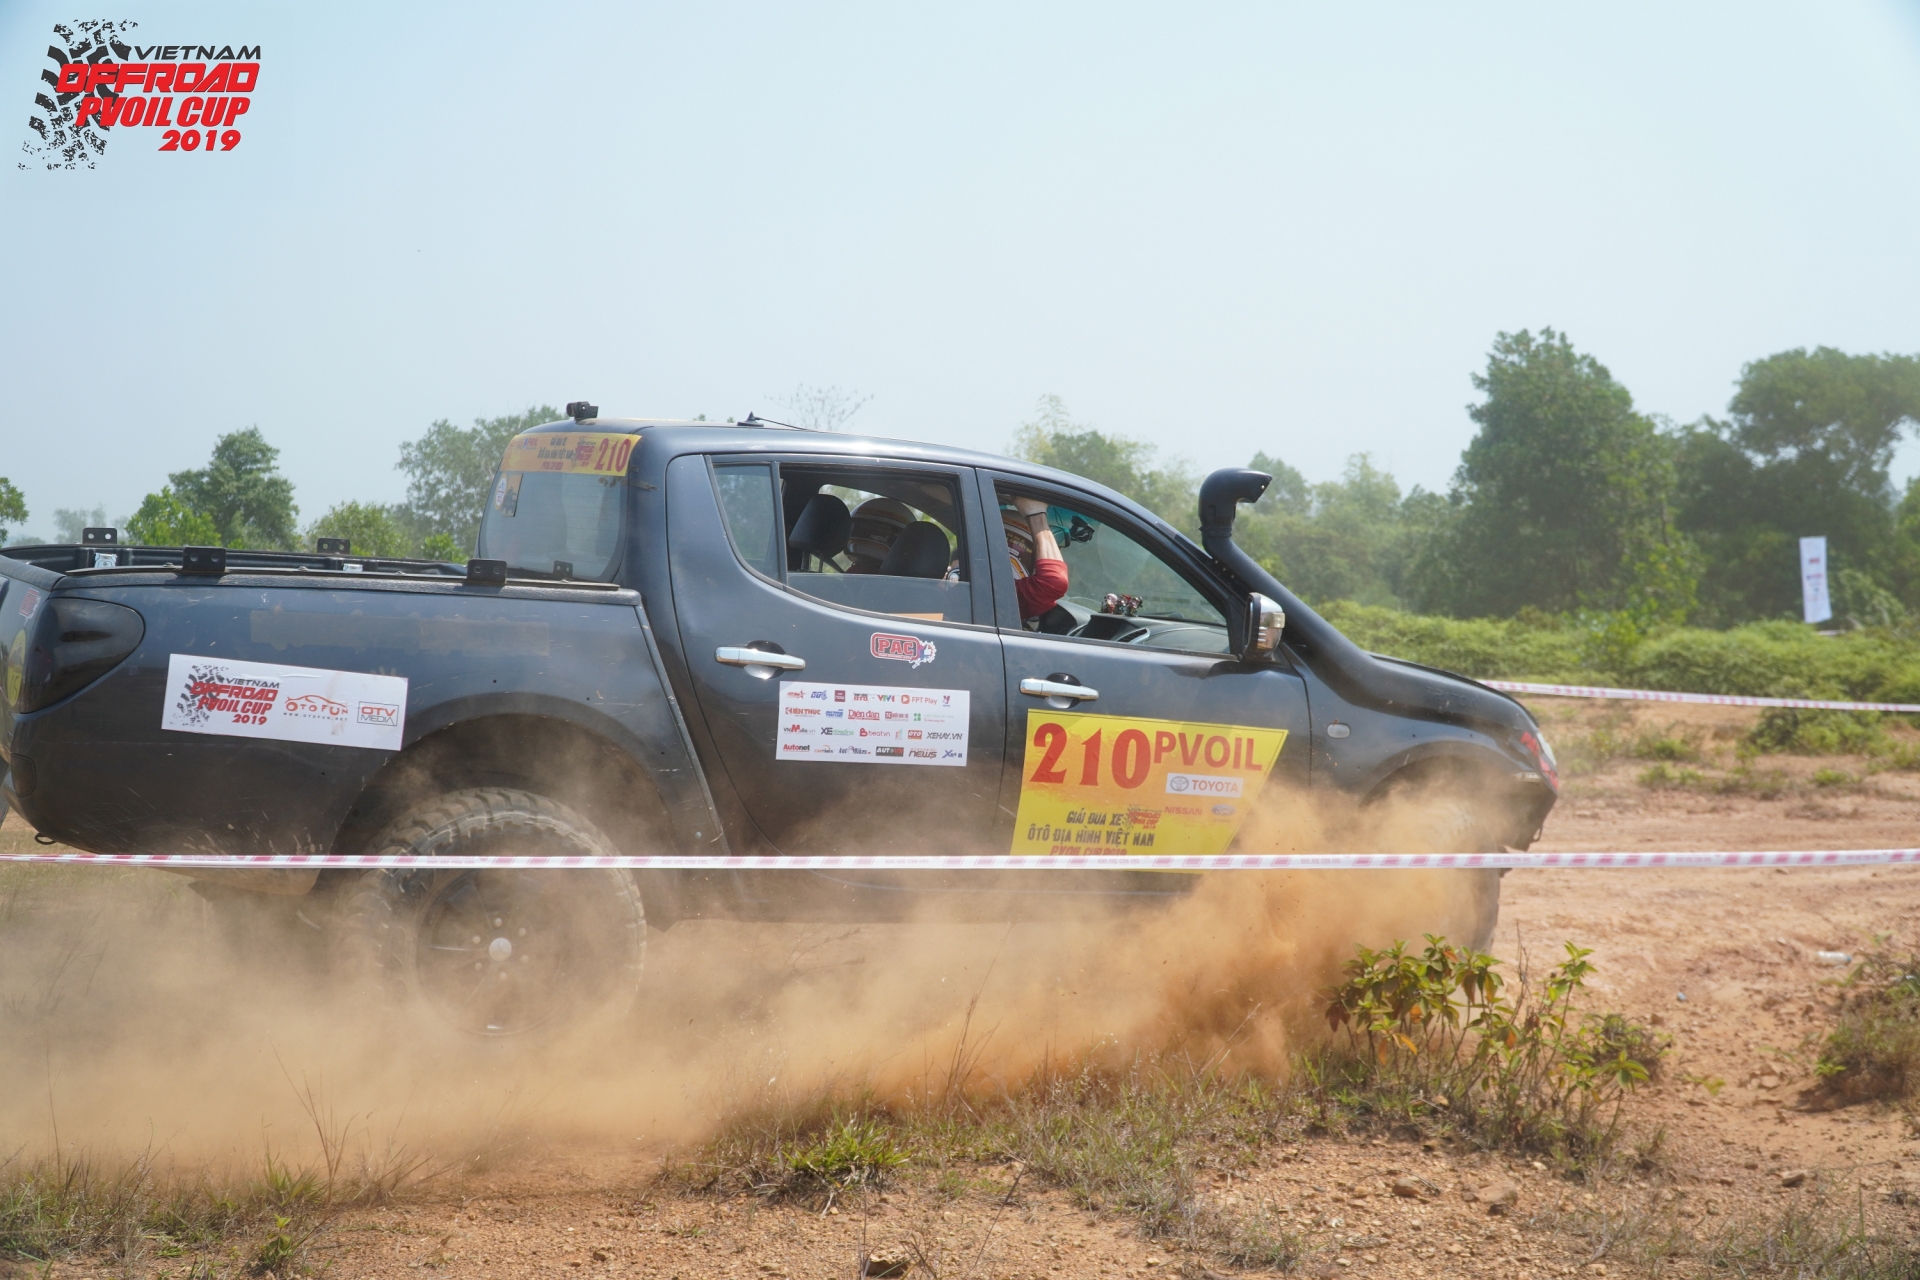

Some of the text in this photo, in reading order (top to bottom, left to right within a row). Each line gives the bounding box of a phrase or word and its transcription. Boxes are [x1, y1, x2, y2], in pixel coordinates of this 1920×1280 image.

[594, 437, 632, 472] 210
[877, 638, 914, 656] PAC
[225, 677, 280, 689] VIETNAM
[190, 681, 279, 702] OFFROAD
[197, 698, 273, 716] PVOIL CUP
[285, 701, 349, 716] OTOFUN
[924, 697, 938, 705] Play
[231, 713, 267, 725] 2019
[361, 706, 396, 717] OTV
[360, 714, 395, 725] MEDIA
[926, 732, 963, 740] XEHAY.VN
[1030, 722, 1151, 789] 210
[1153, 730, 1263, 771] PVOIL
[1191, 779, 1239, 793] TOYOTA
[1066, 807, 1086, 825] GIẢI
[1109, 813, 1124, 826] XE
[1164, 806, 1203, 816] NISSAN
[1027, 823, 1051, 842] ÔTÔ
[1132, 832, 1155, 847] NAM
